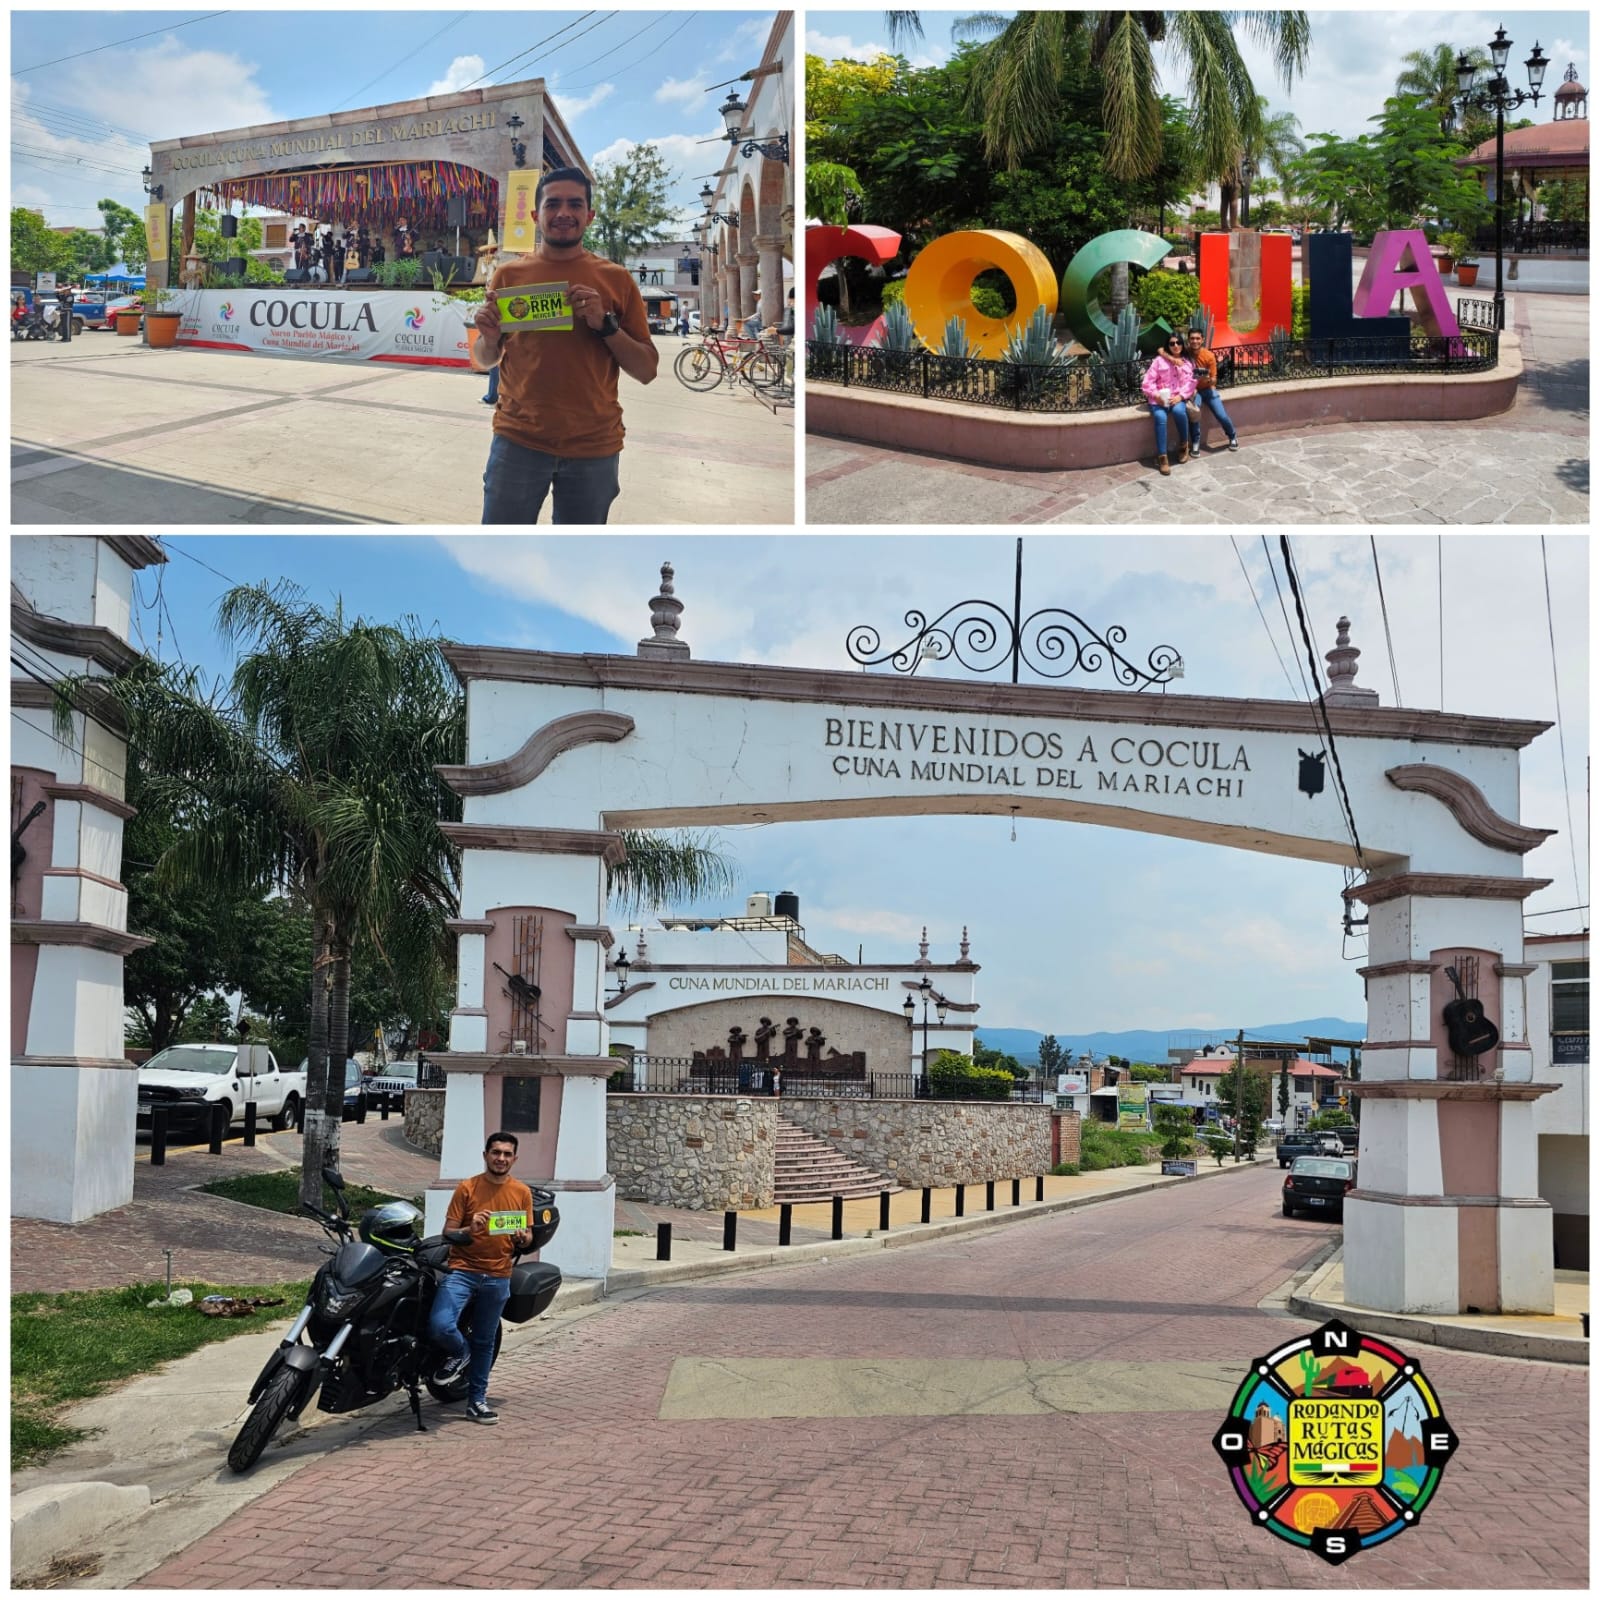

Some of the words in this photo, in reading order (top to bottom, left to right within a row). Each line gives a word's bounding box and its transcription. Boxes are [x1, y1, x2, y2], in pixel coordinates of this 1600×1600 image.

[173, 152, 225, 170] COCULA
[227, 147, 267, 164] CUNA
[269, 133, 346, 158] MUNDIAL
[351, 128, 385, 146] DEL
[391, 110, 496, 141] MARIACHI
[531, 298, 562, 313] RRM
[806, 225, 1469, 364] COCULA
[250, 299, 379, 333] COCULA
[312, 340, 324, 349] del
[825, 718, 1063, 760] BIENVENIDOS
[1078, 735, 1098, 763] A
[1111, 737, 1251, 772] COCULA
[832, 756, 901, 778] CUNA
[910, 760, 1026, 786] MUNDIAL
[1037, 767, 1083, 790] DEL
[1098, 770, 1244, 798] MARIACHI
[669, 977, 710, 990] CUNA
[713, 978, 780, 991] MUNDIAL
[783, 978, 810, 991] DEL
[813, 978, 889, 991] MARIACHI
